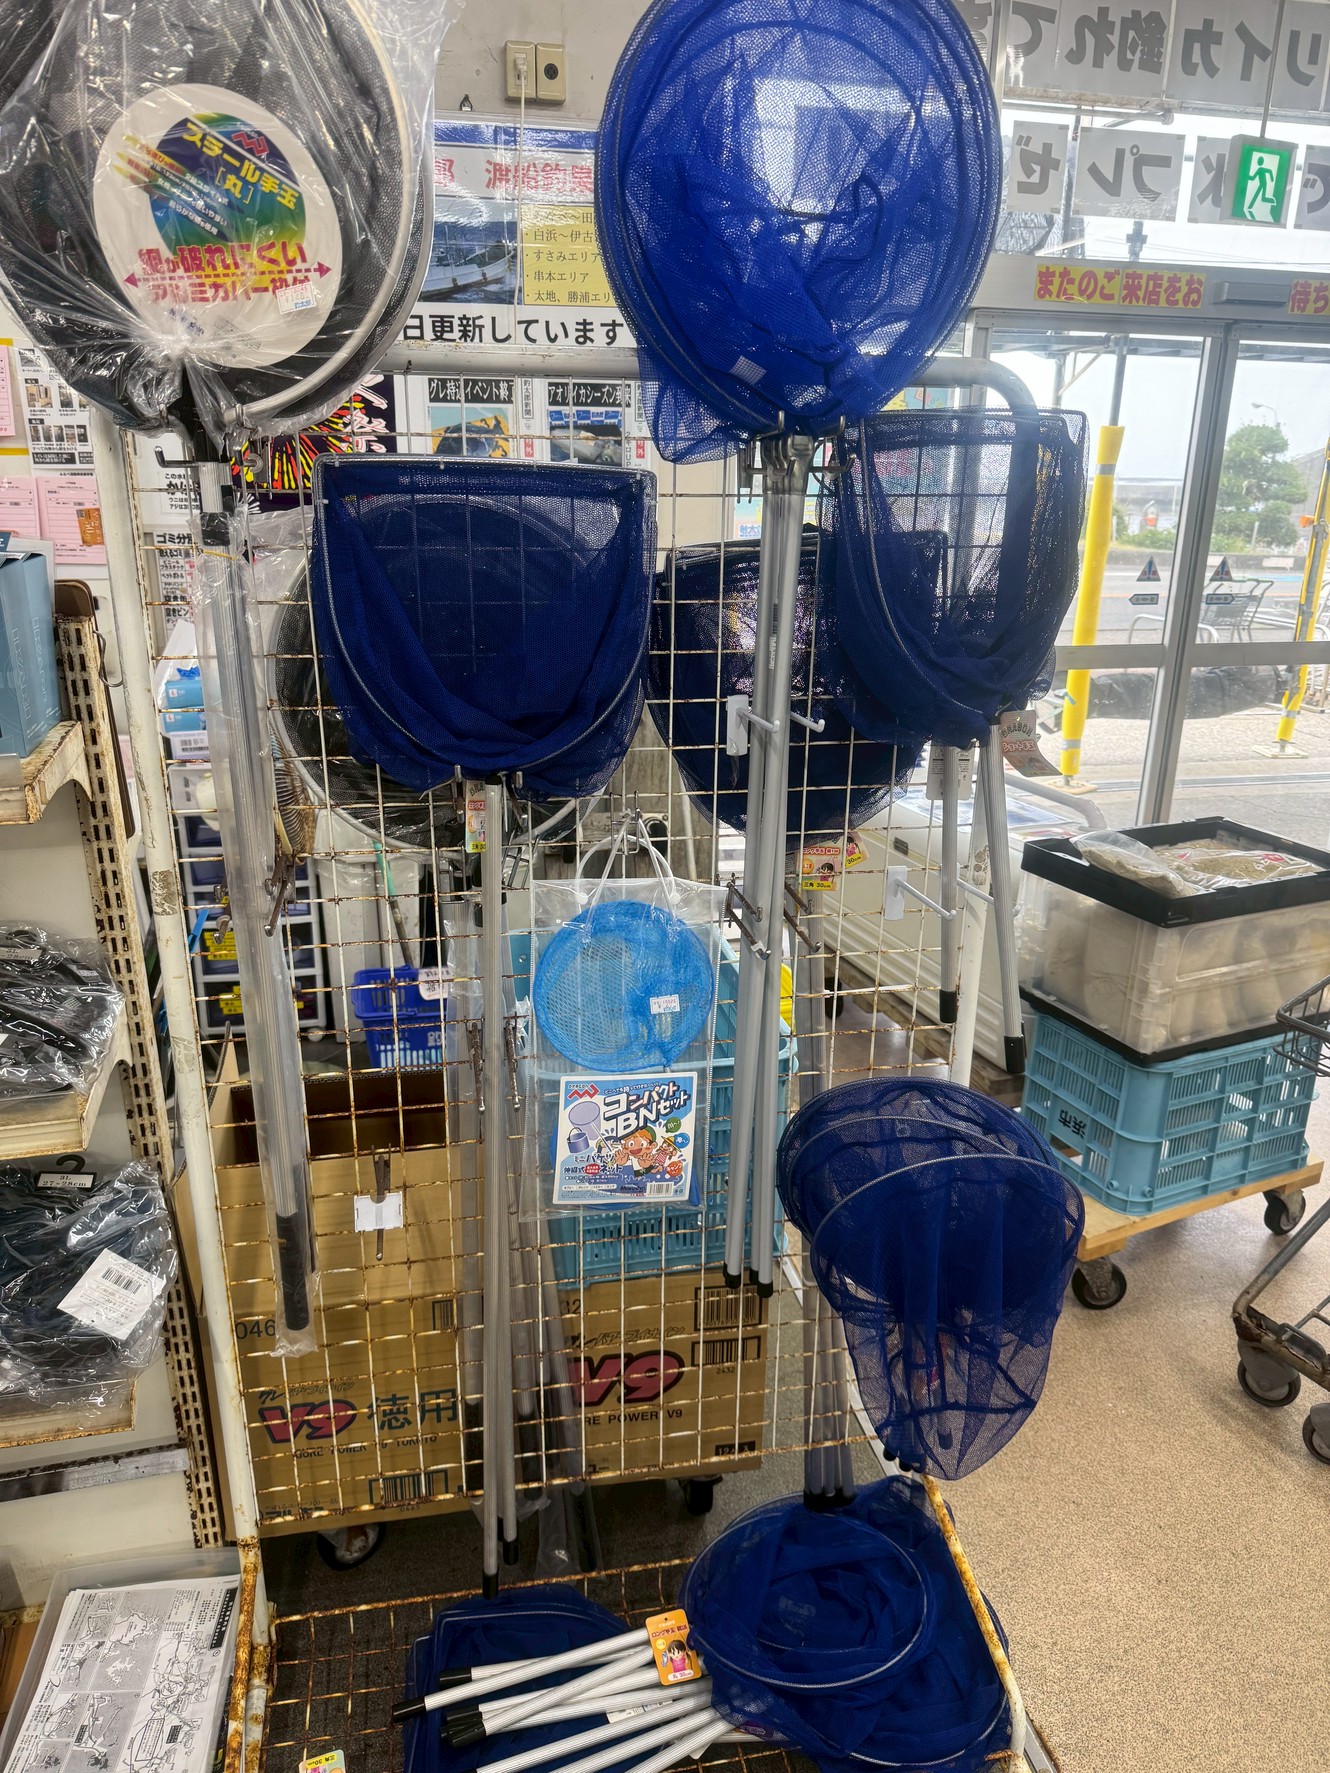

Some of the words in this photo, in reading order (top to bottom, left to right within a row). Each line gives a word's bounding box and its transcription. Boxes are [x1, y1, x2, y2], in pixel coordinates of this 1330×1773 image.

[139, 240, 308, 276] 網が破れにくい
[533, 249, 600, 264] すさみエリア
[533, 270, 590, 284] 串本エリア
[1036, 266, 1205, 308] またのご来店をお
[403, 314, 625, 346] 日更新しています
[258, 1399, 358, 1444] V9
[367, 1388, 458, 1430] 徳用
[608, 1411, 659, 1424] POWER
[667, 1408, 683, 1419] V9
